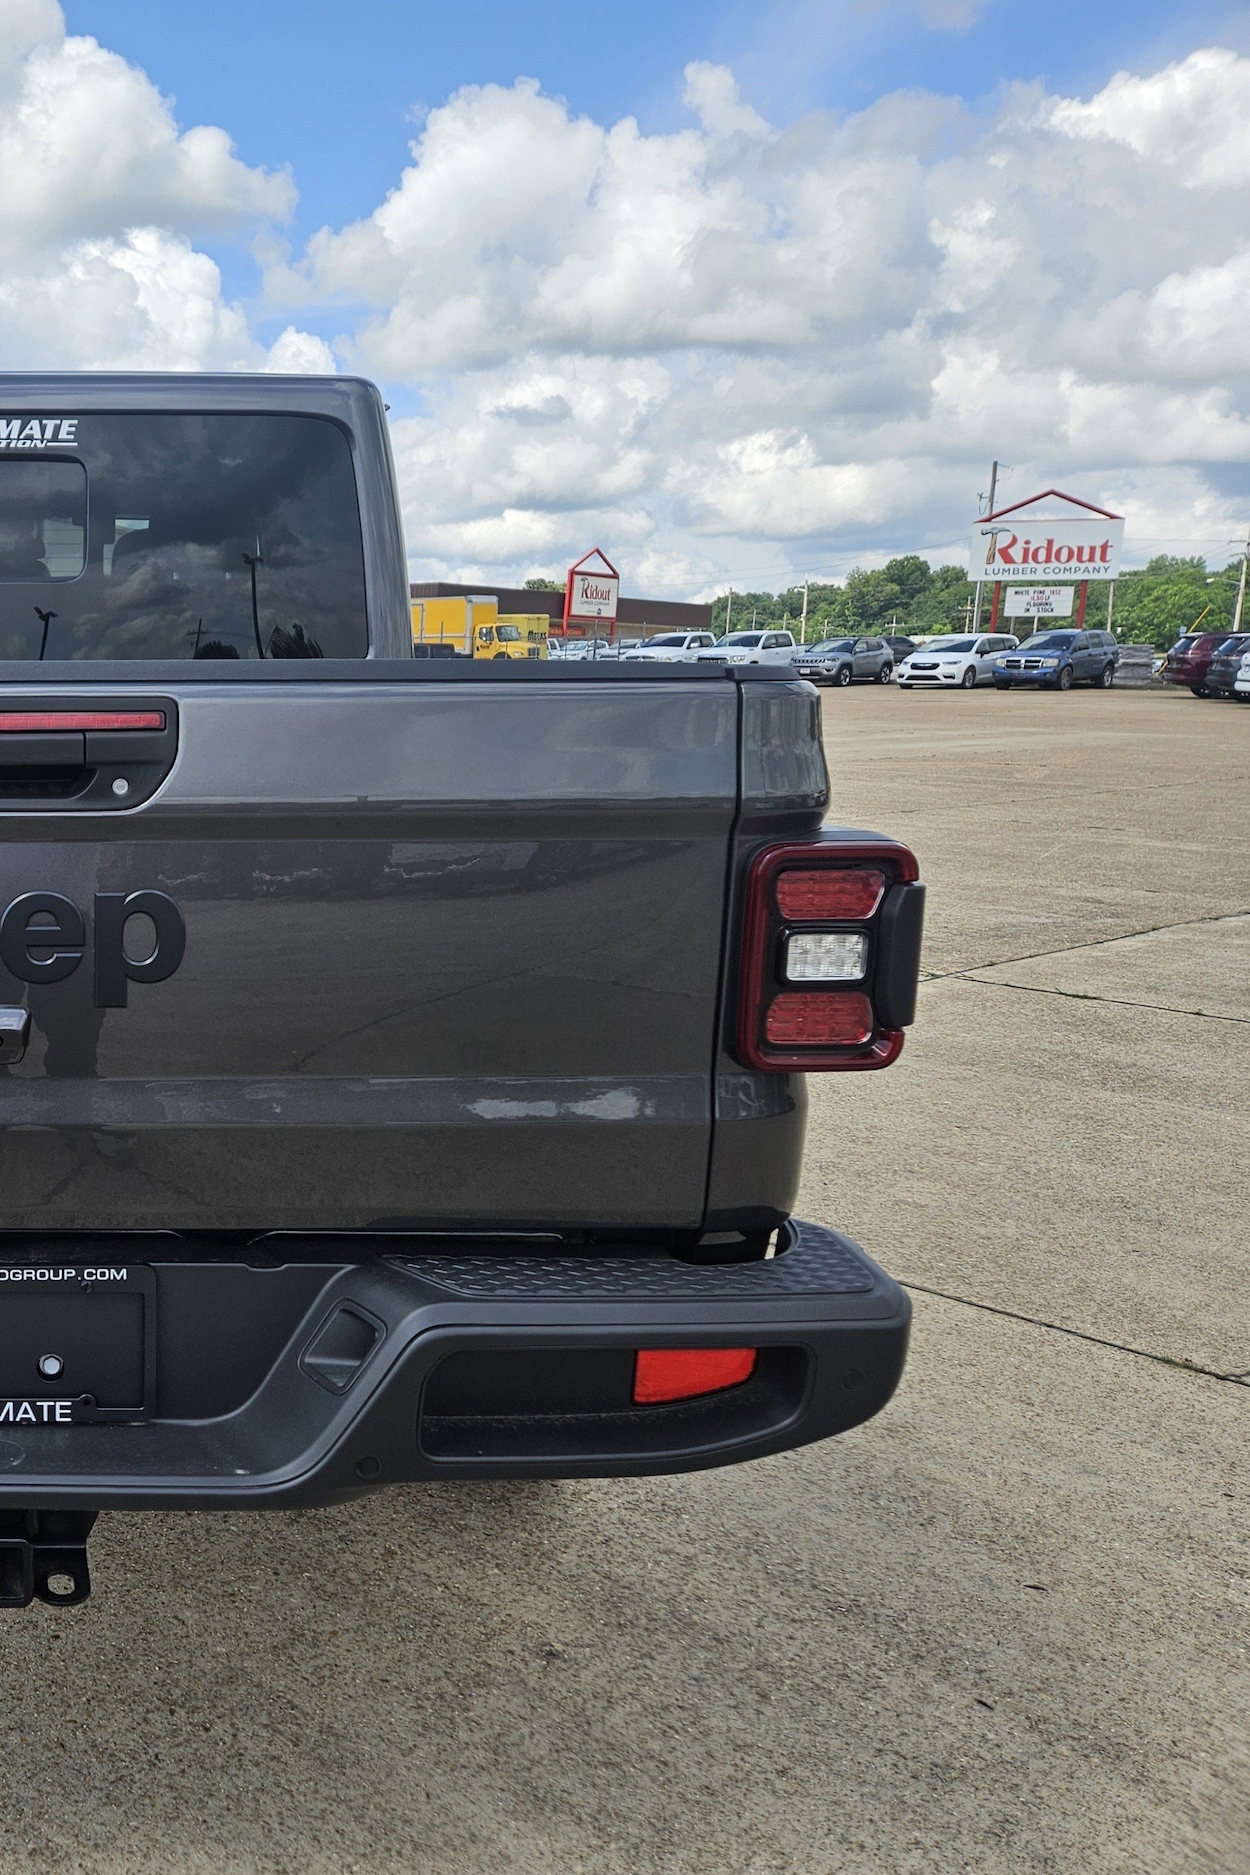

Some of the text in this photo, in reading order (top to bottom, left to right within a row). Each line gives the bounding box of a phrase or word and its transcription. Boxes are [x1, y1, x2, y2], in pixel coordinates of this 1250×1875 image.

[981, 527, 1113, 564] Ridout
[984, 565, 1111, 576] LUMBER COMPANY
[580, 576, 611, 601] Ridout
